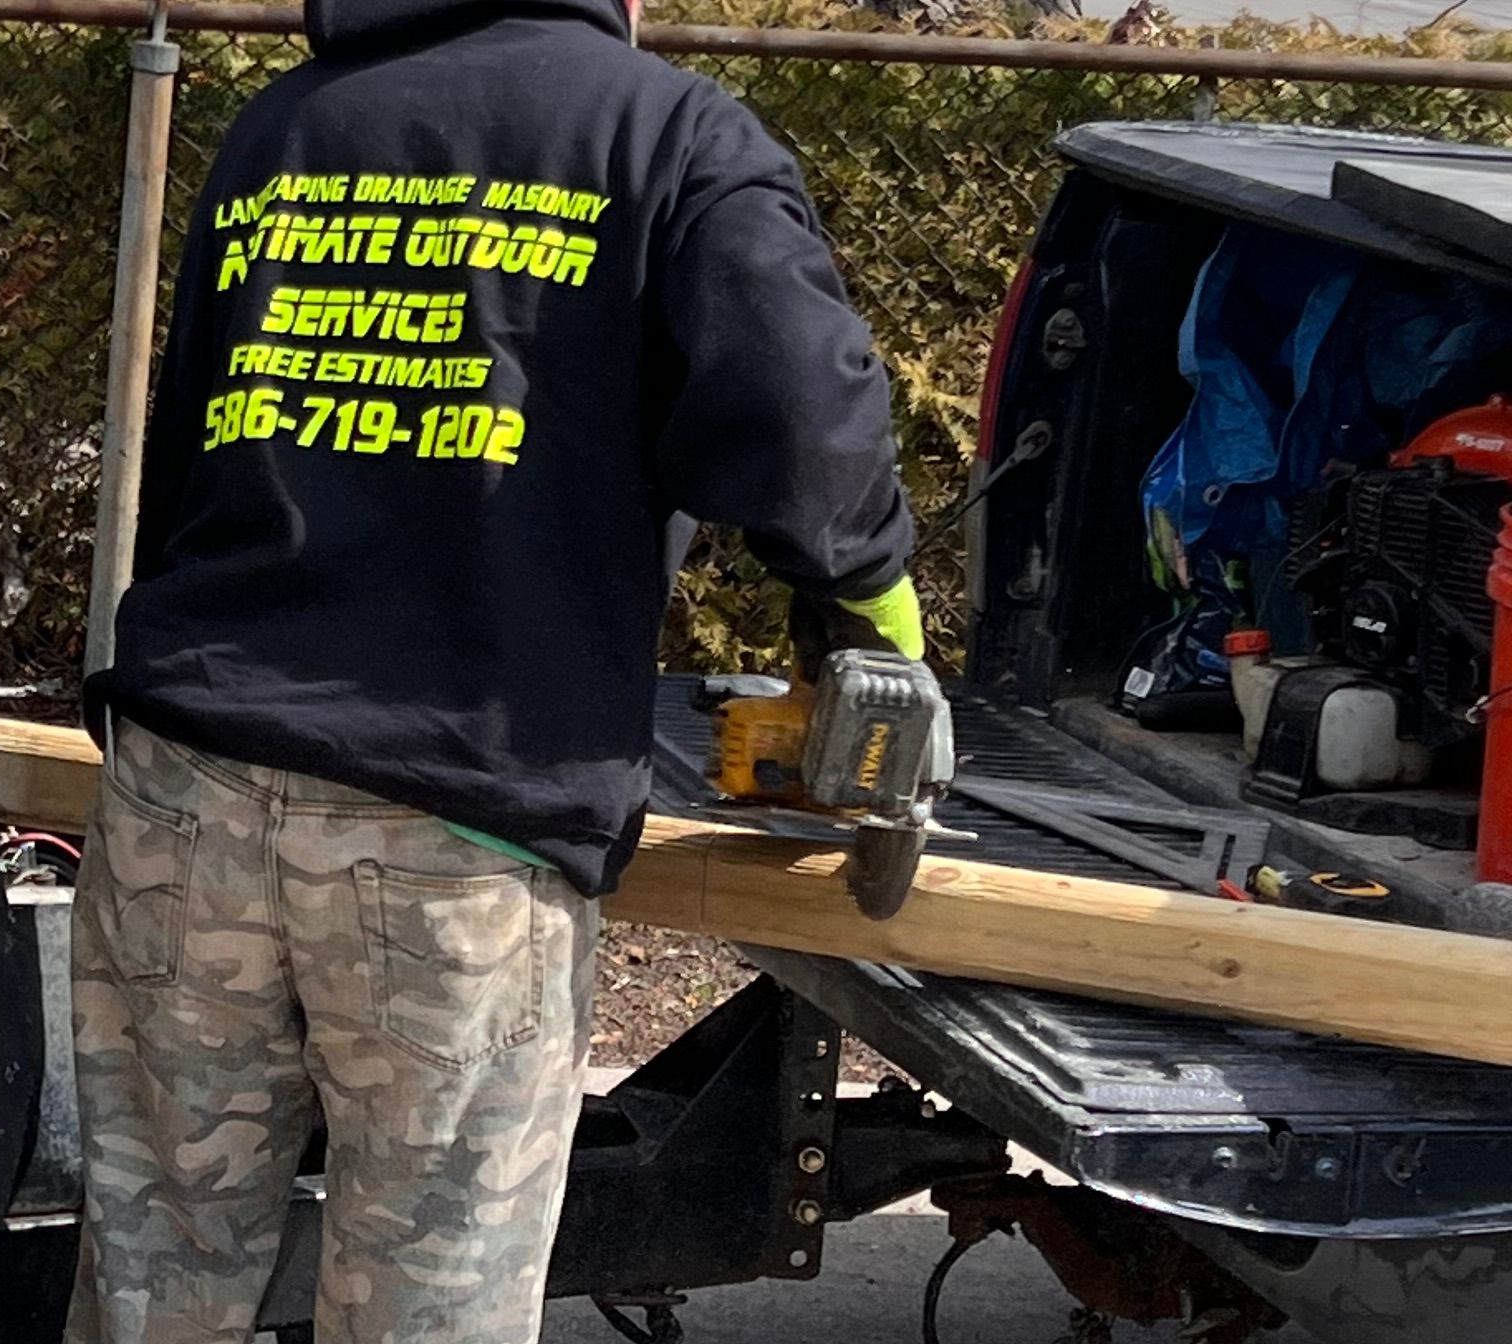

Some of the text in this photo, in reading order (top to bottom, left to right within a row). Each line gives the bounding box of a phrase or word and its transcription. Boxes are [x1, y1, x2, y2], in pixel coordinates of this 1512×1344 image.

[352, 173, 477, 207] DRAINAGE
[481, 180, 611, 224] MASONRY
[404, 216, 599, 288] OUTDOOR
[261, 285, 468, 344] SERVICES
[227, 343, 494, 390] FREE ESTIMATES
[202, 386, 527, 466] 586-719-1202
